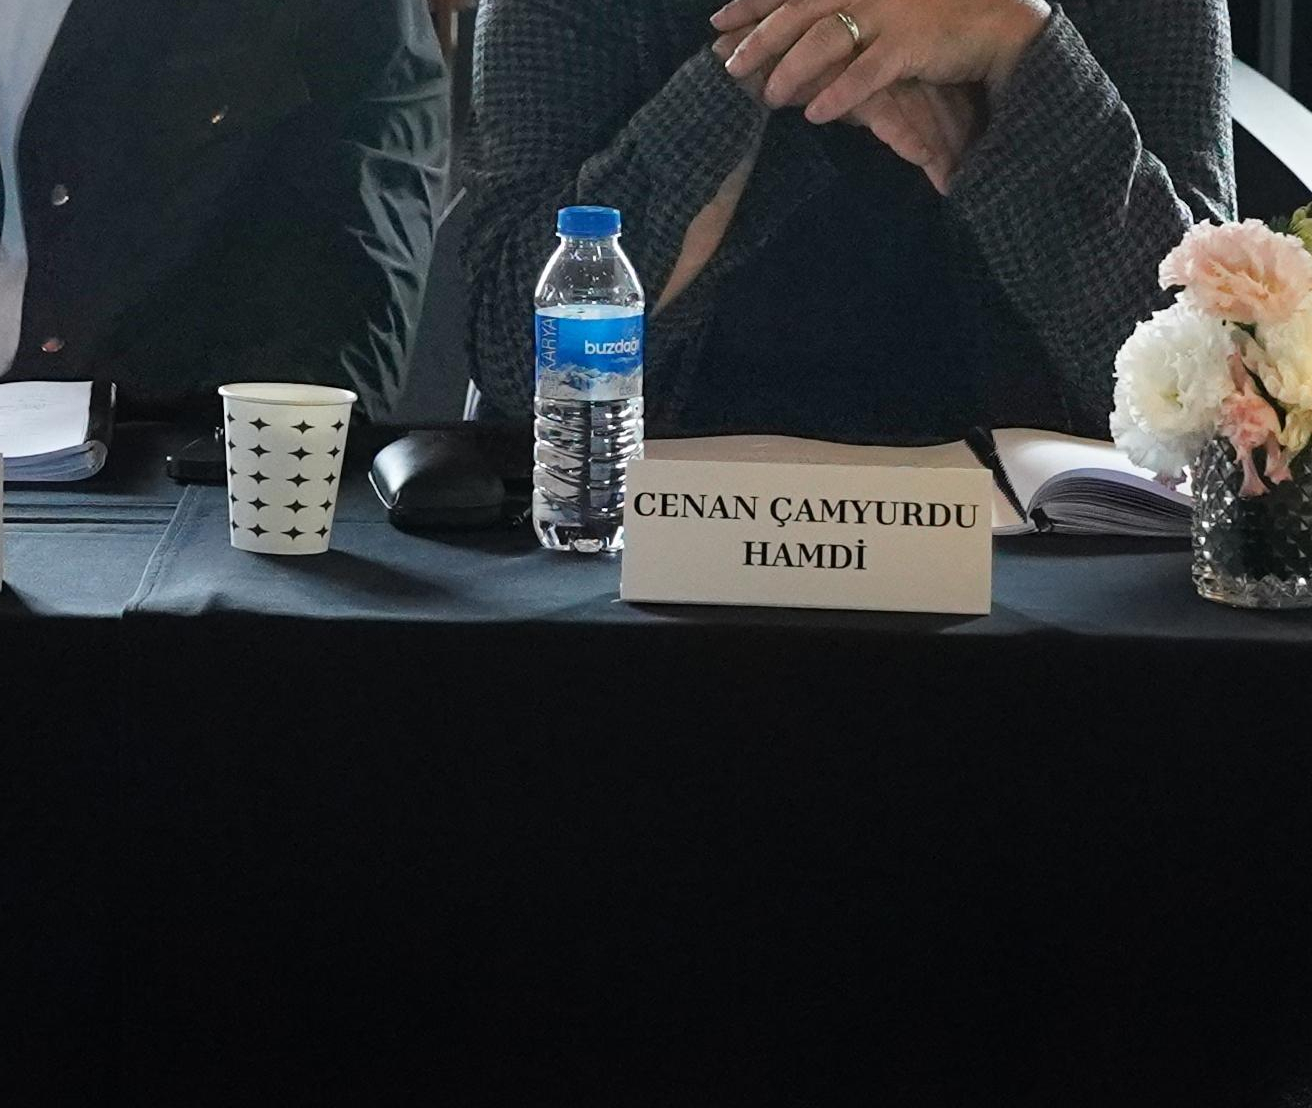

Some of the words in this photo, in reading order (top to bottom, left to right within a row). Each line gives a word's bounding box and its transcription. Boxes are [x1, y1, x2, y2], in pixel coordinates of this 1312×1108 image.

[633, 492, 759, 521] CENAN
[770, 497, 978, 529] ÇAMYURDU
[742, 539, 867, 570] HAMDİ
